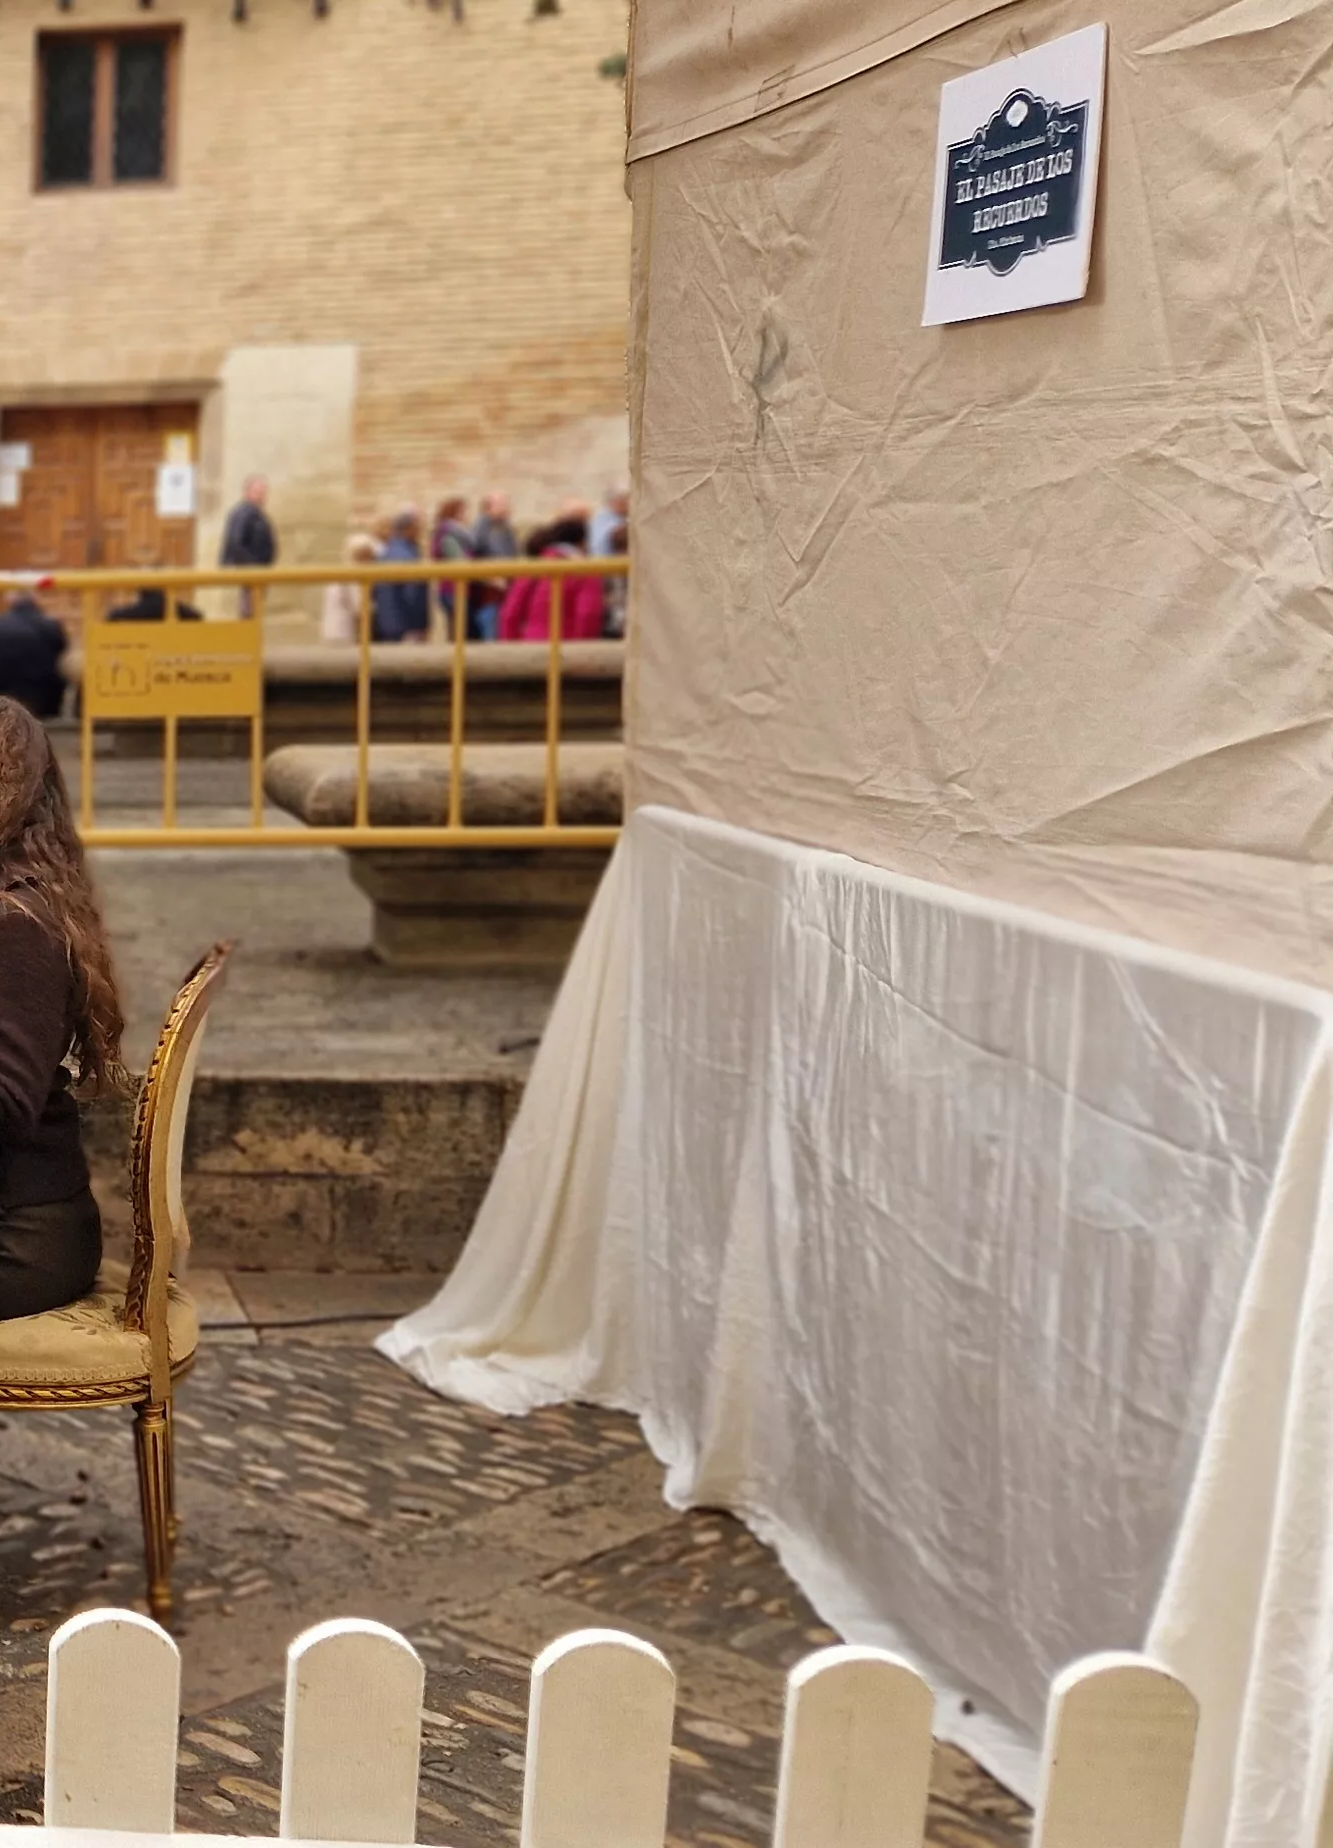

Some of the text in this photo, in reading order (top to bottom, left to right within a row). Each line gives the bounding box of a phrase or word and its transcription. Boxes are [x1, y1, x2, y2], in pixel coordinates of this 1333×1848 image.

[955, 148, 1074, 204] EL PASAJE DE LOS
[971, 191, 1050, 234] RECUERDOS
